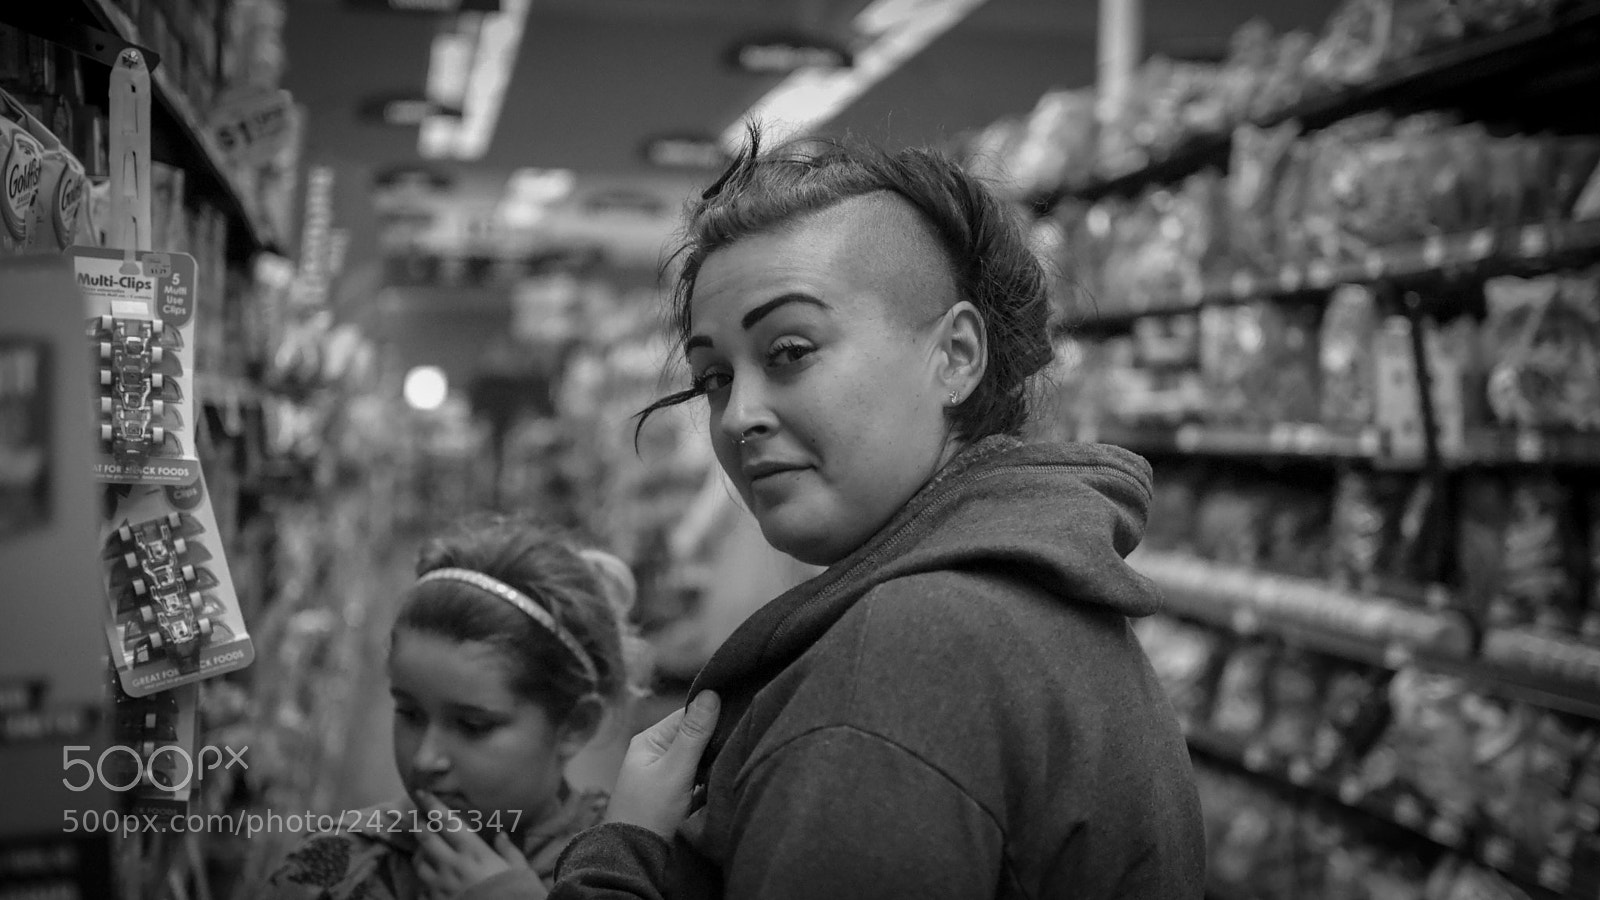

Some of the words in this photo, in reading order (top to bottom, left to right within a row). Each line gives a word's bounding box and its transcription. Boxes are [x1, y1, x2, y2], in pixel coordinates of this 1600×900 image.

[78, 273, 153, 292] Multi-Clips
[172, 273, 181, 285] 5
[164, 286, 188, 296] Multi
[167, 295, 184, 305] Use
[163, 305, 187, 315] Clips
[158, 466, 189, 476] FOODS
[213, 650, 244, 663] FOODS
[132, 673, 160, 687] GREAT
